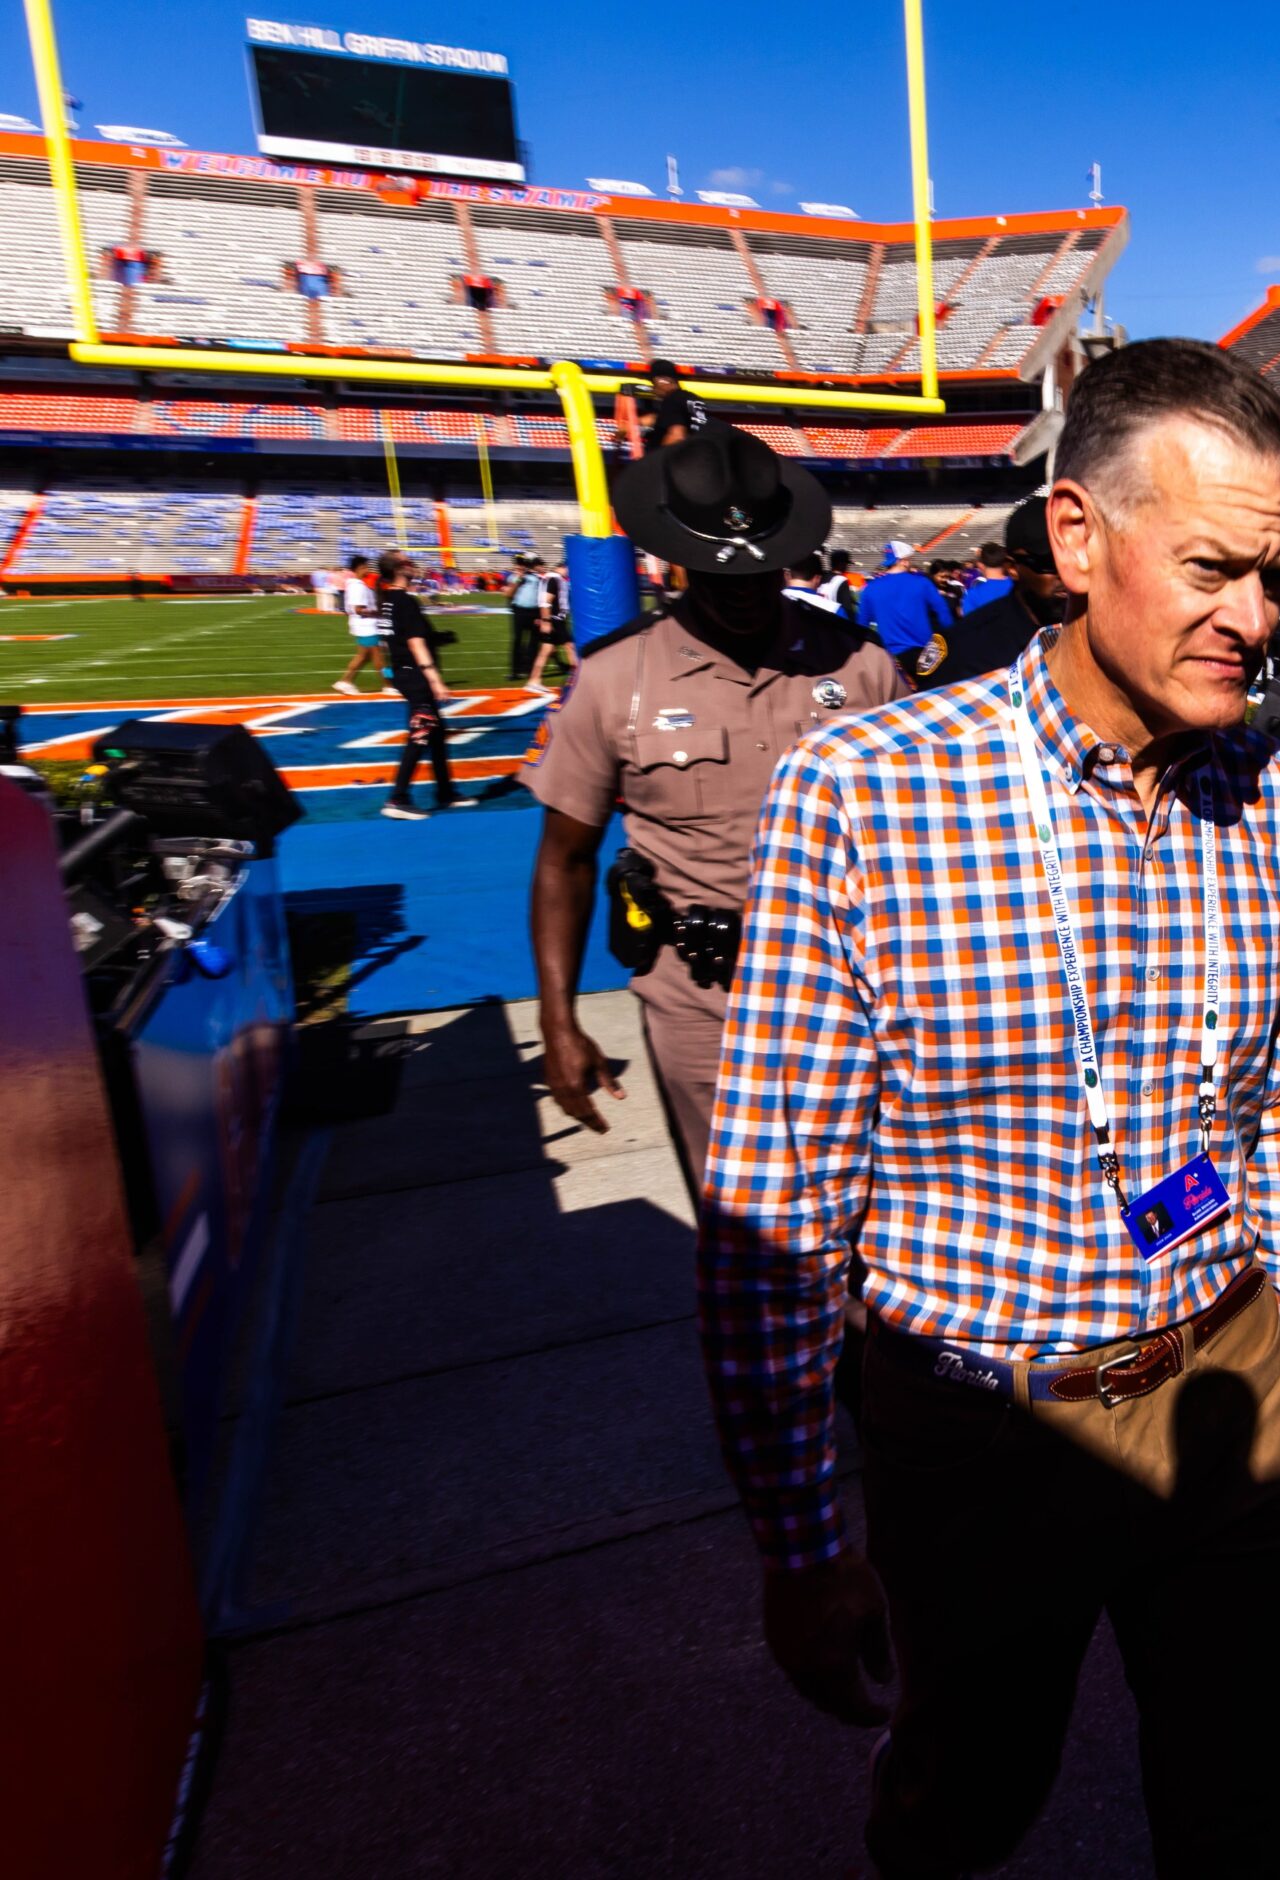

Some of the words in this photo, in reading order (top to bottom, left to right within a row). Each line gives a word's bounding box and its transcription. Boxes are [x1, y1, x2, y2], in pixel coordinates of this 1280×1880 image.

[1202, 809, 1217, 875] CHAMPIONSHIP
[1043, 849, 1063, 896] INTEGRITY
[1053, 898, 1069, 925] WITH
[1206, 877, 1218, 929] EXPERIENCE
[1058, 925, 1081, 982] EXPERIENCE
[1207, 933, 1219, 956] WITH
[1206, 959, 1219, 1006] INTEGRITY
[1070, 984, 1093, 1055] CHAMPIONSHIP
[933, 1351, 999, 1391] Florida
